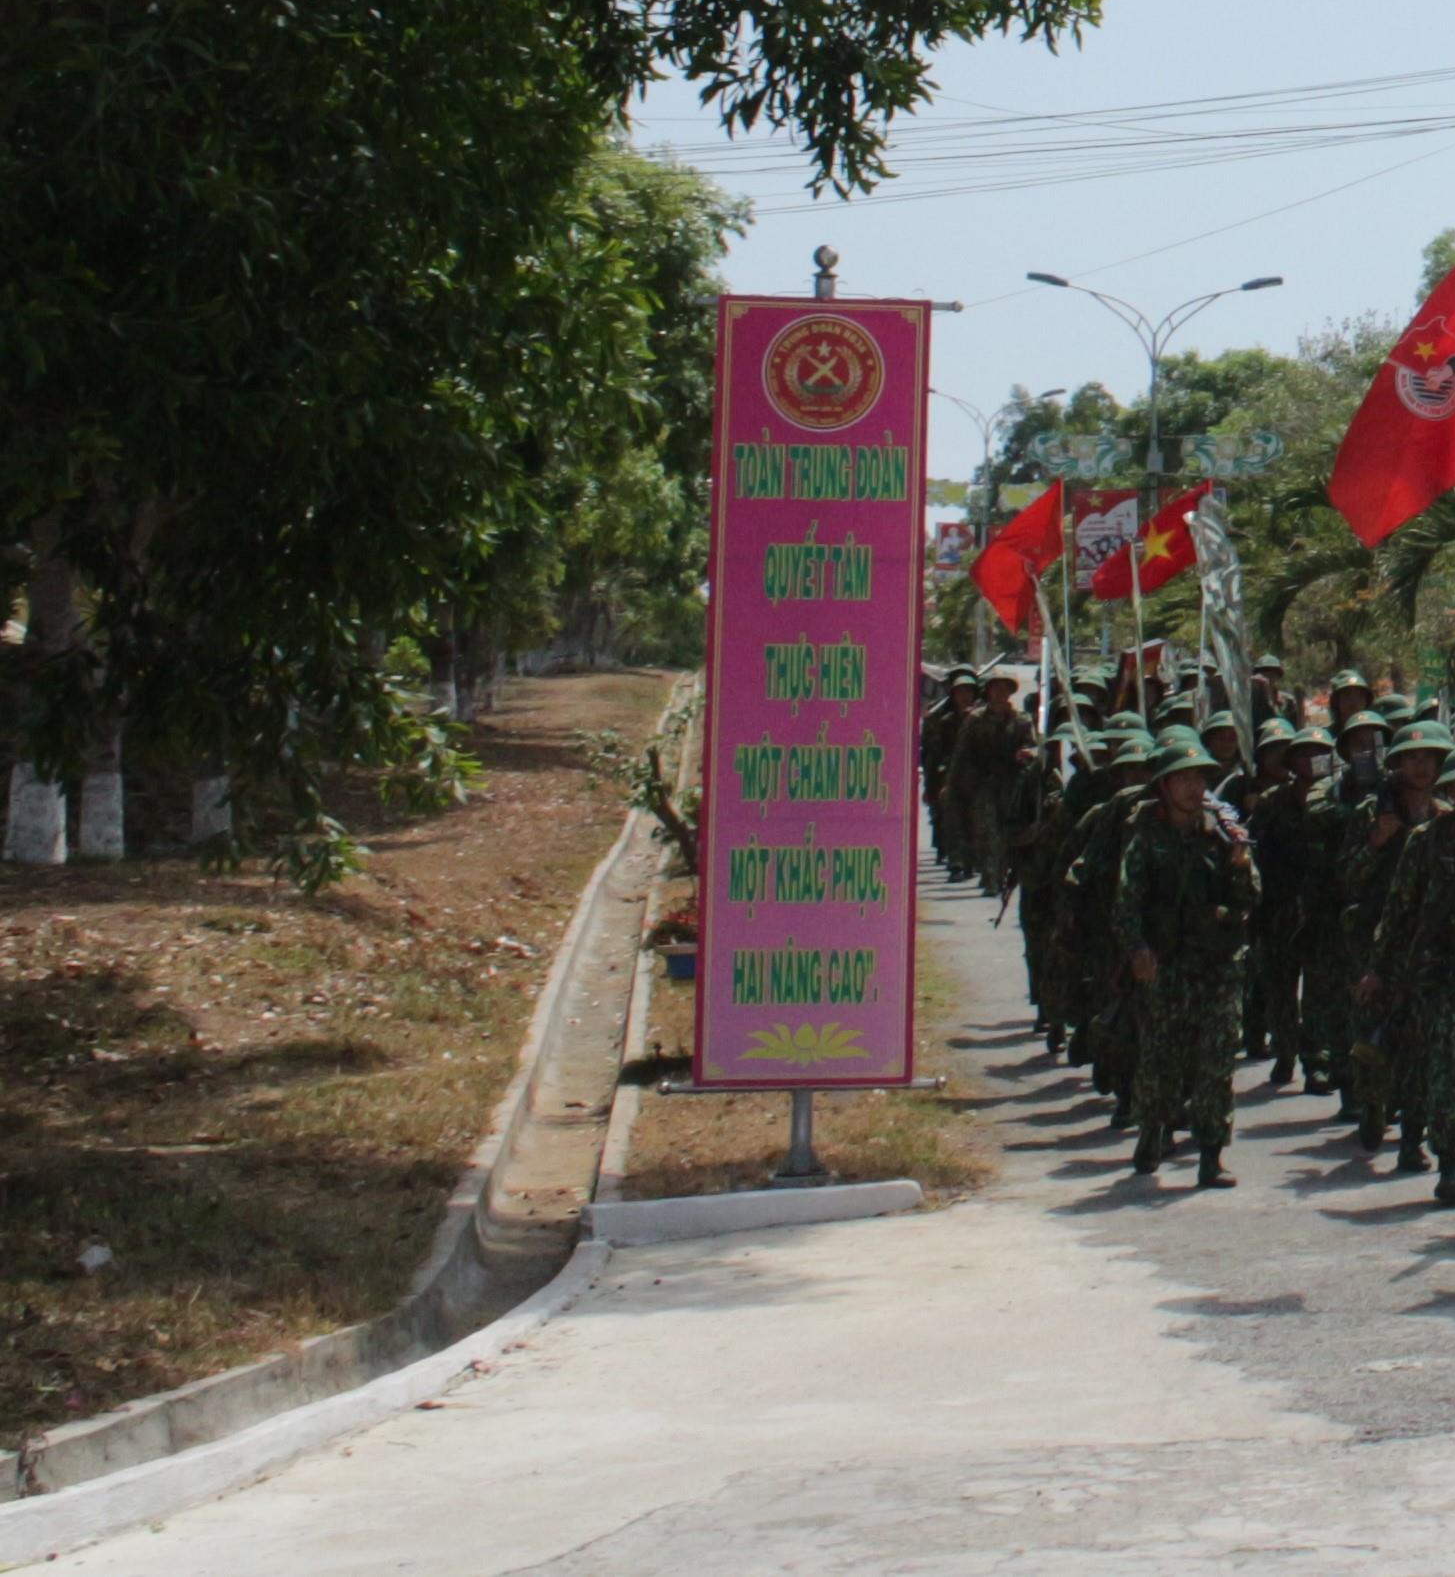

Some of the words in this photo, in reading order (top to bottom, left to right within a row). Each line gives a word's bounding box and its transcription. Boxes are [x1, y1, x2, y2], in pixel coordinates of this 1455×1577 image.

[734, 427, 786, 499] TOÀN
[788, 445, 852, 501] TRUNG
[855, 430, 908, 501] ĐOÀN
[765, 520, 829, 606] QUYẾT
[831, 532, 872, 600] TÂM
[765, 631, 816, 718] THỰC
[819, 630, 866, 718] HIỆN
[787, 720, 843, 801] CHẤM
[845, 728, 890, 814] DỨT,
[729, 834, 771, 919] MỘT
[774, 821, 827, 903] KHẮC
[831, 846, 888, 919] PHỤC,
[732, 950, 765, 1004] HAI
[770, 936, 822, 1005] NÂNG
